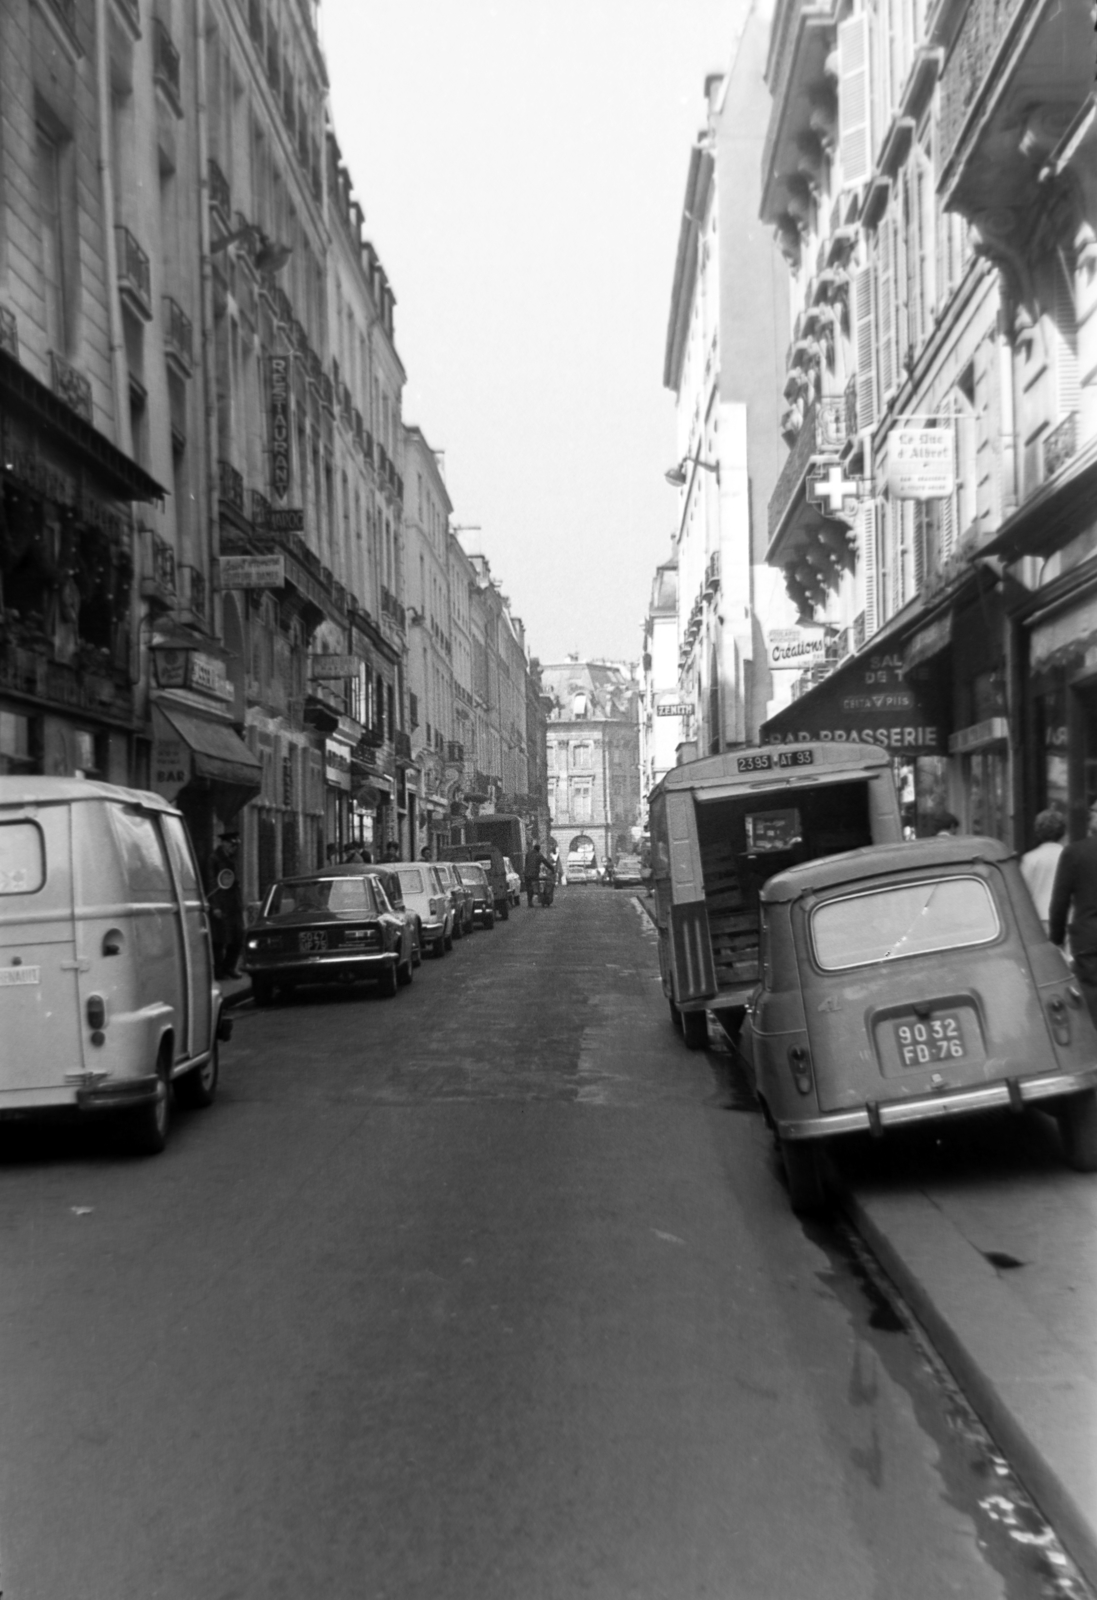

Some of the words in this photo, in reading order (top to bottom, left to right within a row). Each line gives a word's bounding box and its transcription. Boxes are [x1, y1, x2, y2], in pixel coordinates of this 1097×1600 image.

[272, 359, 288, 496] RESTAURANT
[772, 639, 822, 662] Créations
[865, 671, 887, 684] DE
[658, 705, 692, 715] ZENITH
[738, 755, 769, 771] 2395
[780, 753, 793, 765] AT
[796, 751, 811, 764] 93
[157, 770, 185, 783] BAR
